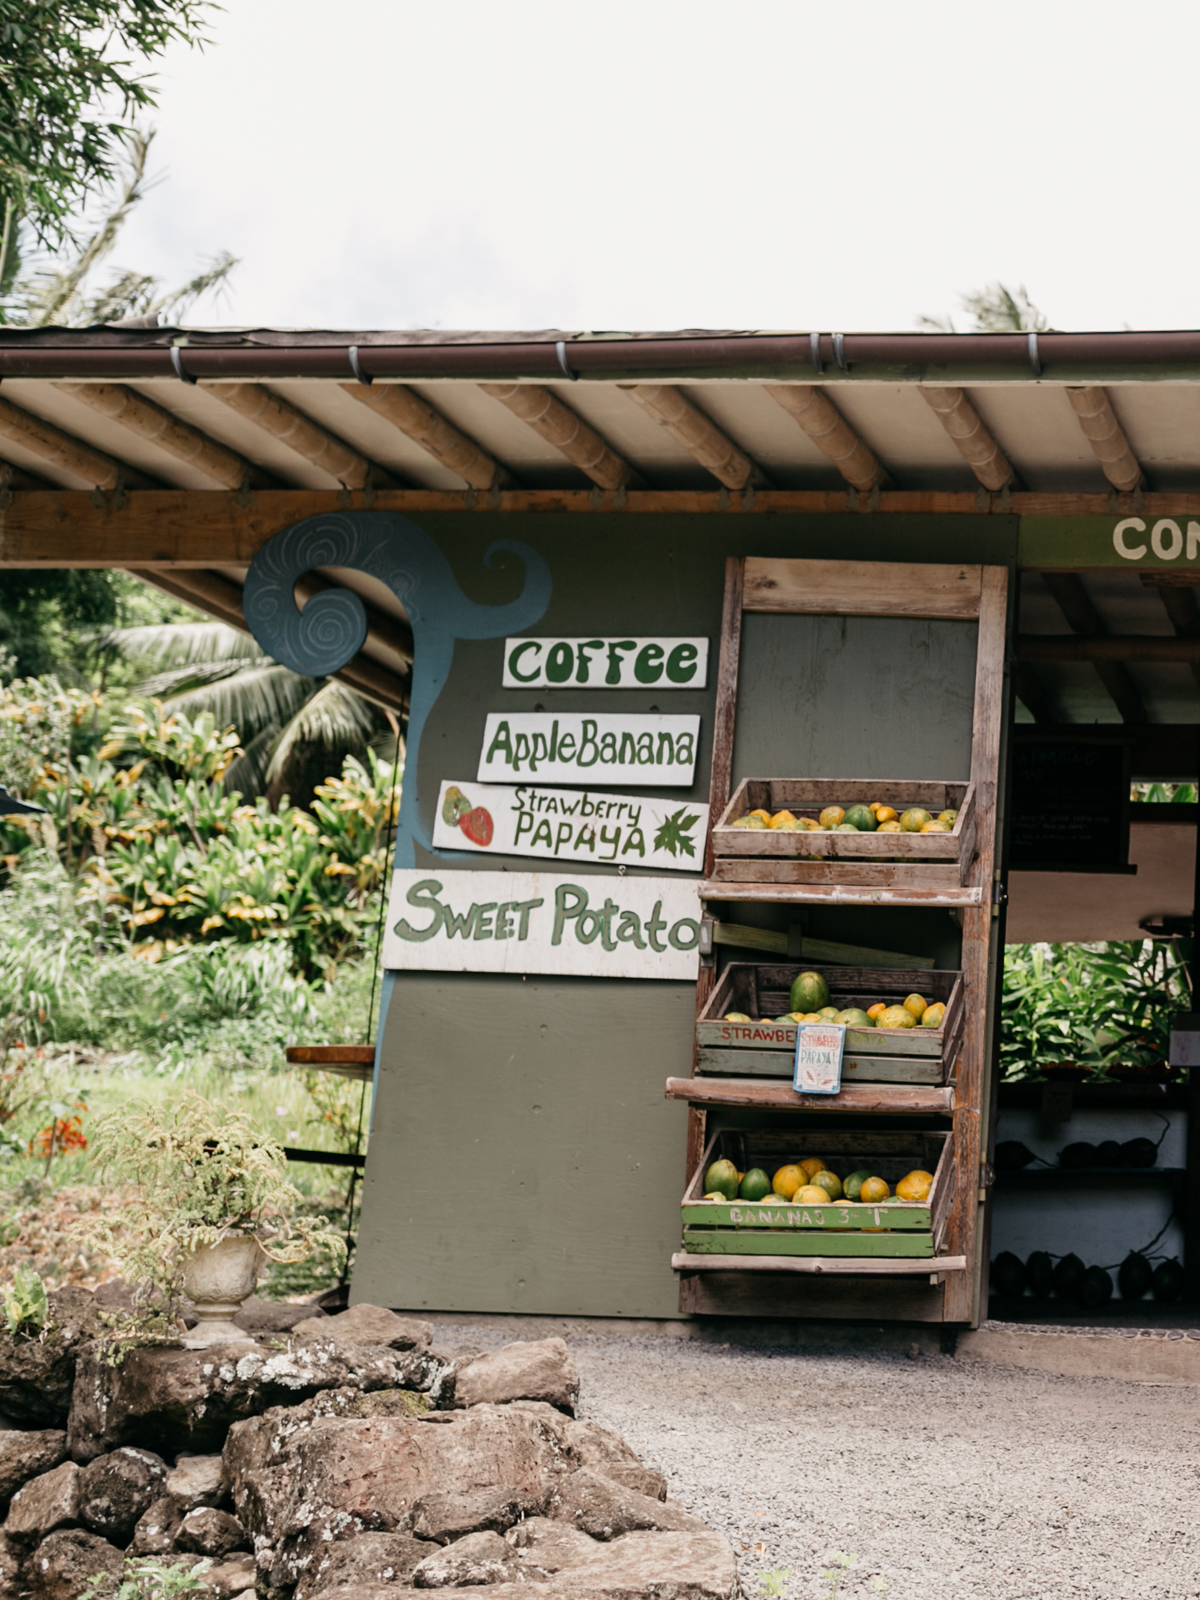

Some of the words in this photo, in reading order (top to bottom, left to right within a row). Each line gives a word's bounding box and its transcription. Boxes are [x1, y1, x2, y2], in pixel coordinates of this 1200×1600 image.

[551, 884, 701, 952] Potato
[721, 1027, 797, 1044] STRAWBE
[846, 1032, 888, 1047] APAYA
